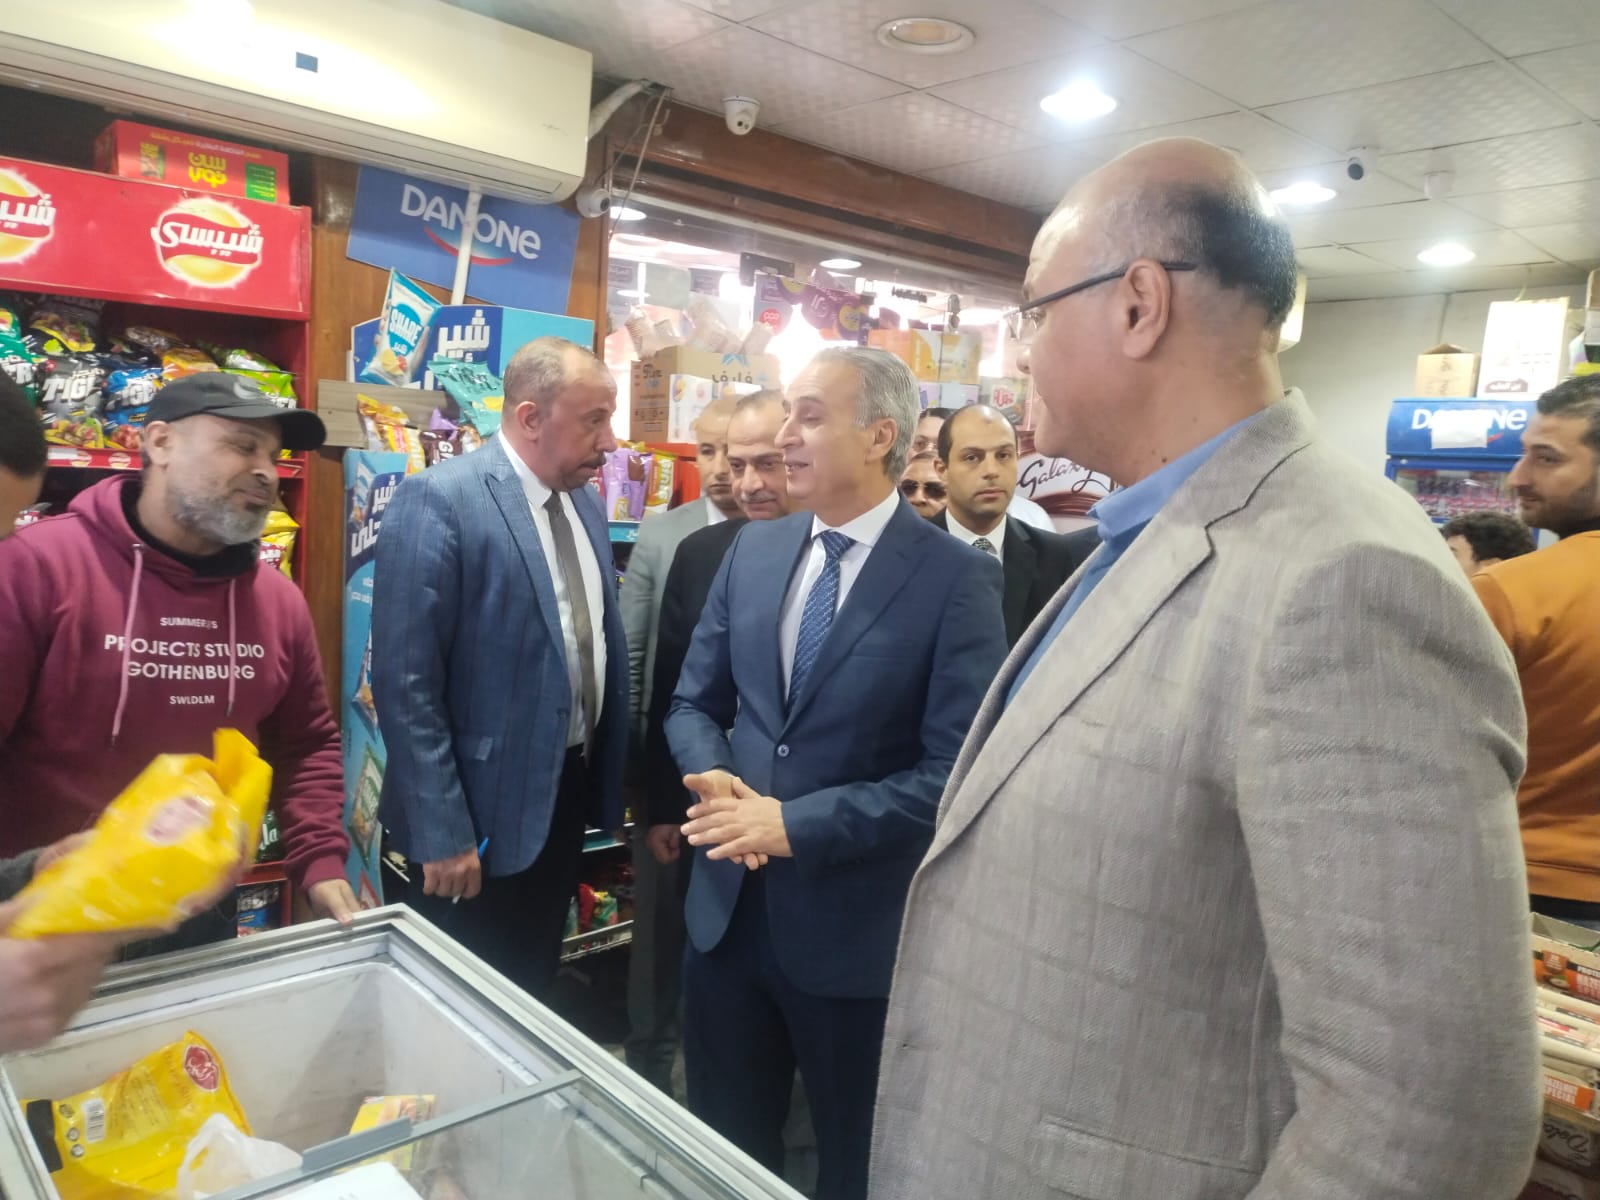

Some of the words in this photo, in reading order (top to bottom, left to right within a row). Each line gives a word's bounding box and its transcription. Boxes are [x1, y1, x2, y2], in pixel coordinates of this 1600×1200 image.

[389, 308, 423, 346] SHARE
[204, 642, 265, 659] STUDIO
[127, 661, 256, 680] GOTHENBURG
